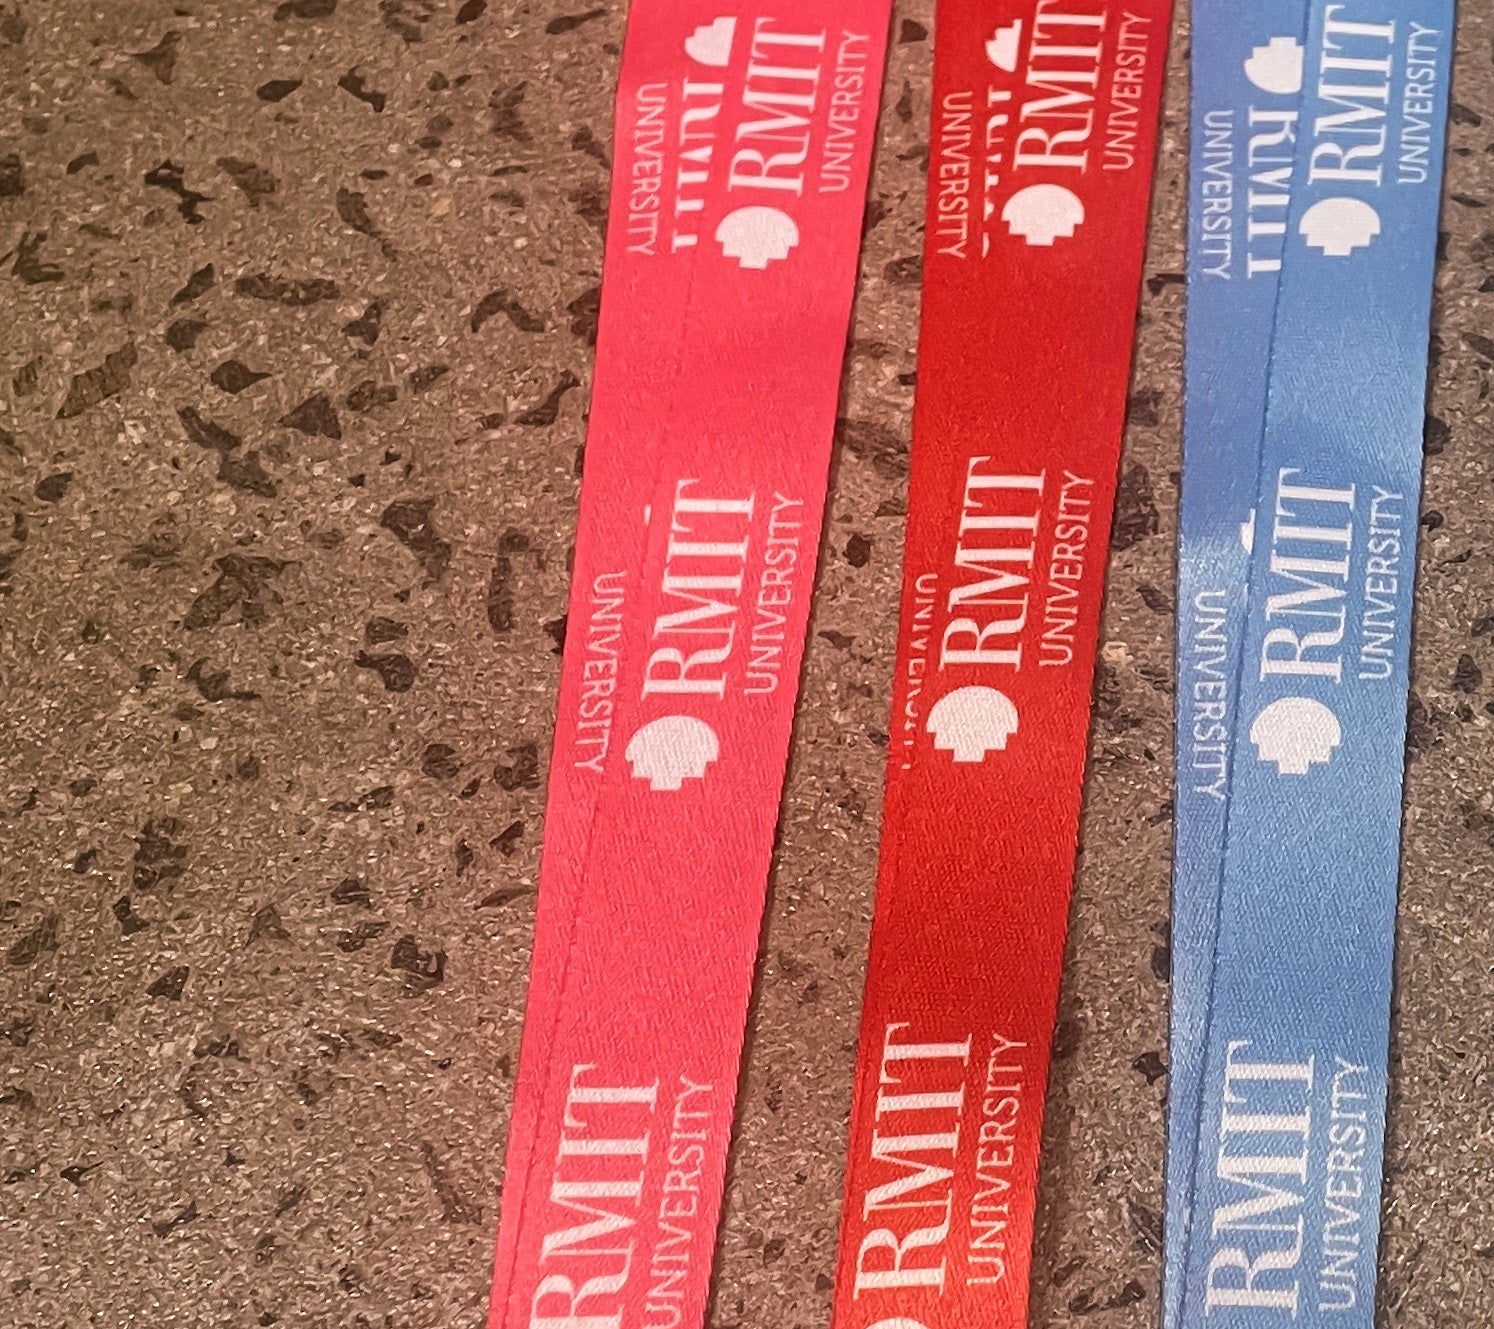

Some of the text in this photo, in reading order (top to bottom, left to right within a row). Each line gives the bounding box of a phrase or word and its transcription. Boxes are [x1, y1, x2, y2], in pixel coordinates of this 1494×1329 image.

[627, 82, 669, 256] UNIVERSITY
[727, 16, 828, 198] RMIT
[819, 28, 871, 194] UNIVERSITY
[935, 91, 973, 259] UNIVERSITY
[1013, 0, 1108, 173] RMIT
[1102, 10, 1153, 172] UNIVERSITY
[1307, 4, 1396, 188] RMIT
[1397, 21, 1443, 185] UNIVERSITY
[1199, 109, 1234, 280] UNIVERSITY
[641, 478, 757, 701] RMIT
[744, 491, 804, 697] UNIVERSITY
[938, 455, 1047, 673] RMIT
[1038, 470, 1097, 668] UNIVERSITY
[1259, 467, 1356, 685] RMIT
[1358, 484, 1405, 681] UNIVERSITY
[573, 570, 628, 774] UNIVERSITY
[1193, 589, 1229, 801] UNIVERSITY
[853, 1021, 973, 1301] RMIT
[966, 1032, 1029, 1287] UNIVERSITY
[1205, 1038, 1316, 1319] RMIT
[1318, 1054, 1370, 1312] UNIVERSITY
